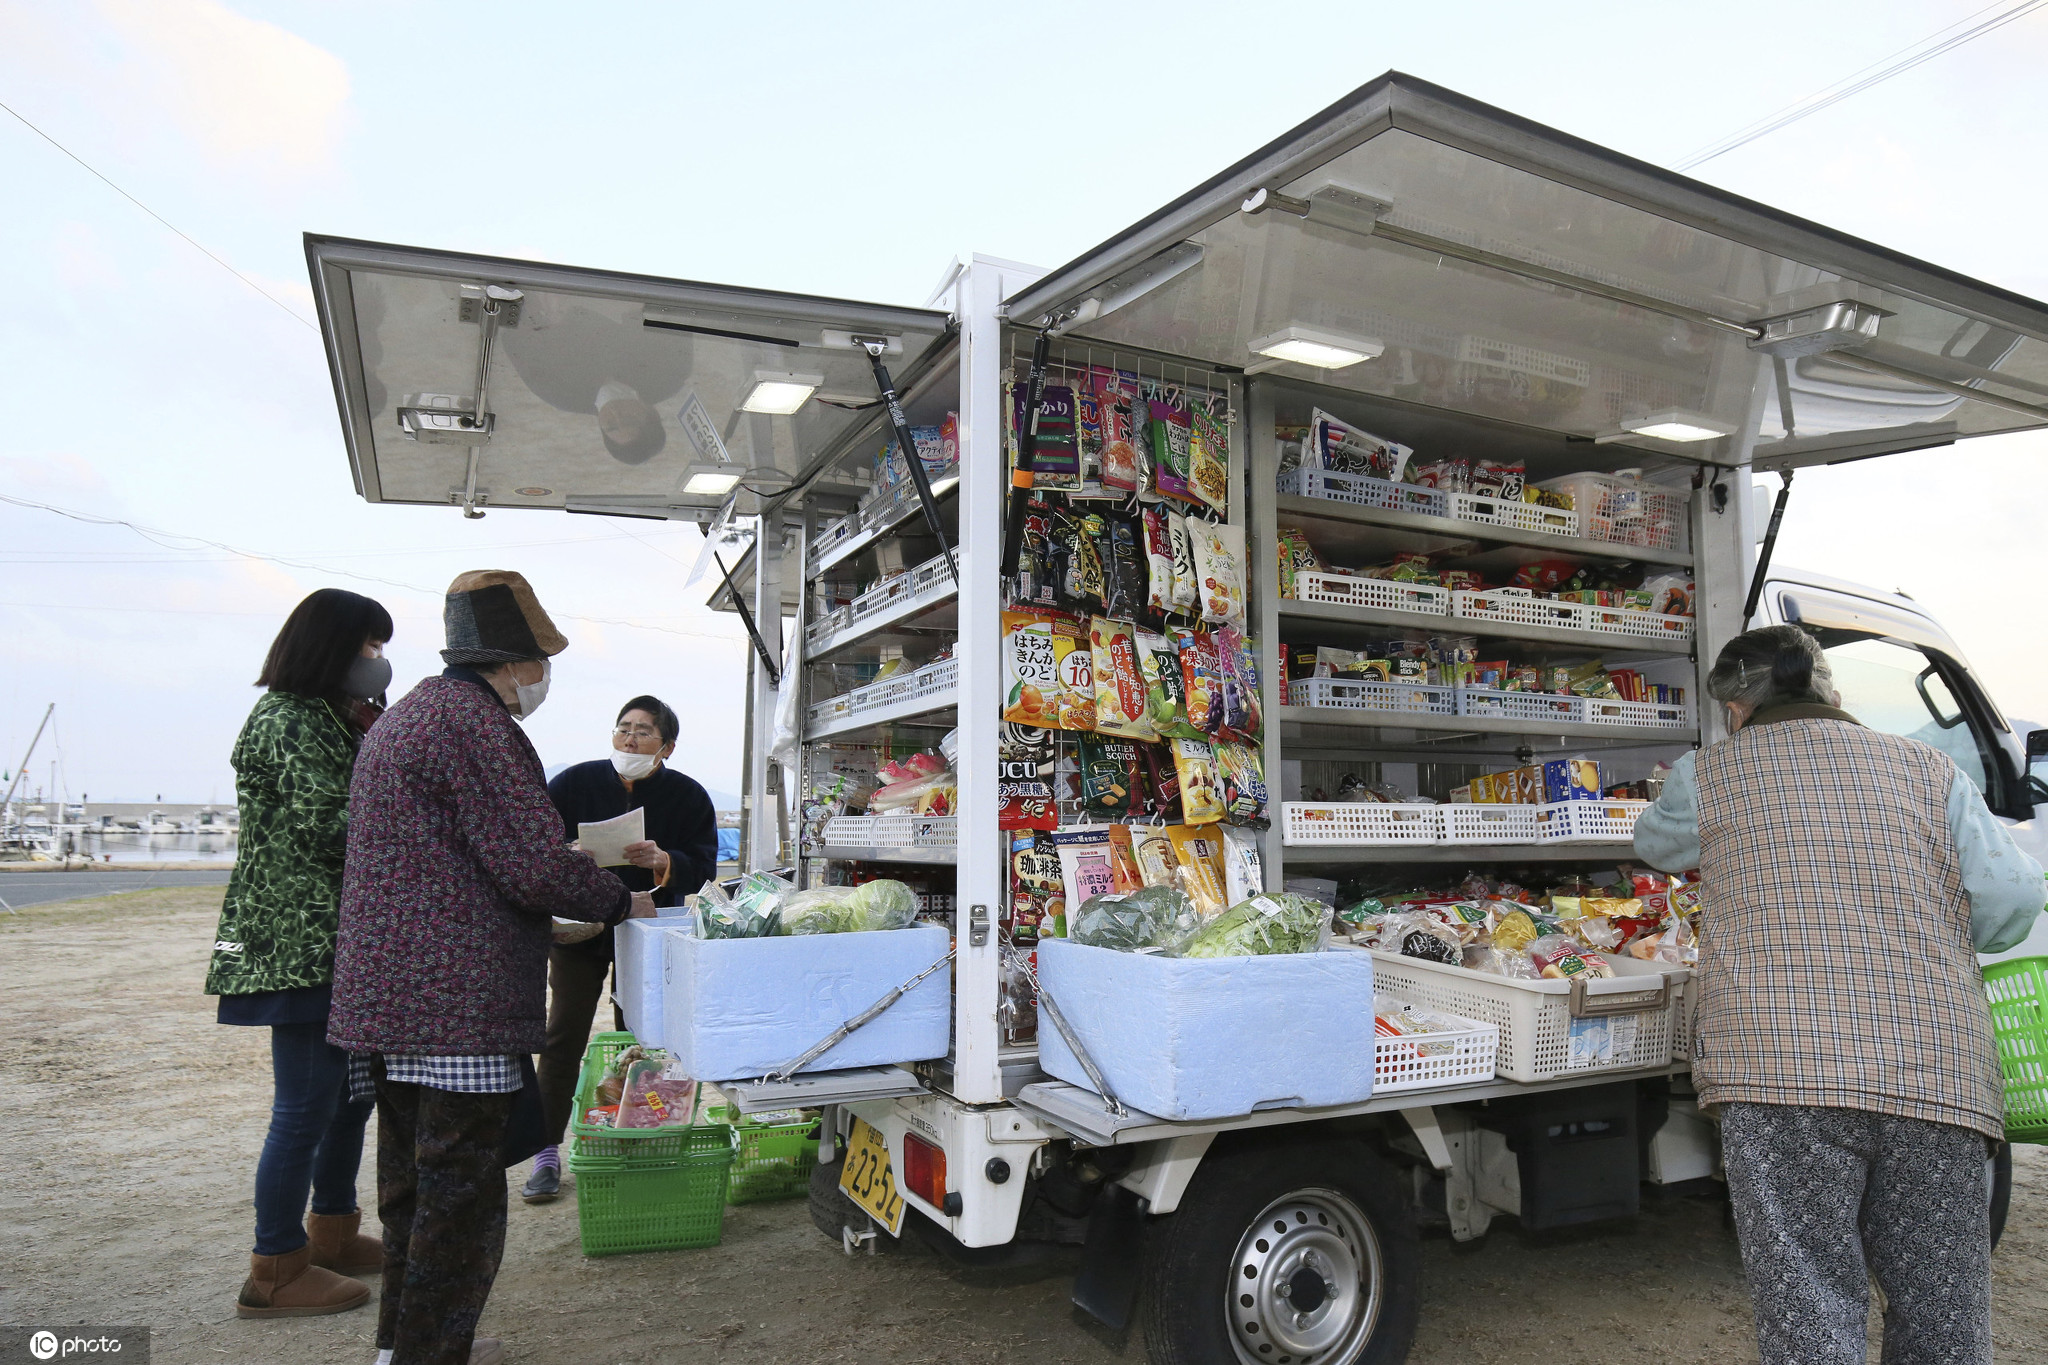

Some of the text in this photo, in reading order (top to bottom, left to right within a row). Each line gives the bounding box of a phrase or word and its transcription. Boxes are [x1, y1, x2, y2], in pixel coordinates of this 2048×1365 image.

[1156, 543, 1173, 558] のど
[1173, 528, 1189, 576] ミルク
[1399, 659, 1420, 670] Blendy
[1018, 664, 1058, 682] のど
[1104, 744, 1135, 753] BUTTER
[1106, 752, 1137, 761] SCOTCH
[1079, 873, 1114, 886] 特濃ミルク
[1090, 885, 1107, 895] 8.2
[648, 1093, 661, 1108] 498
[851, 1147, 896, 1223] 23-52
